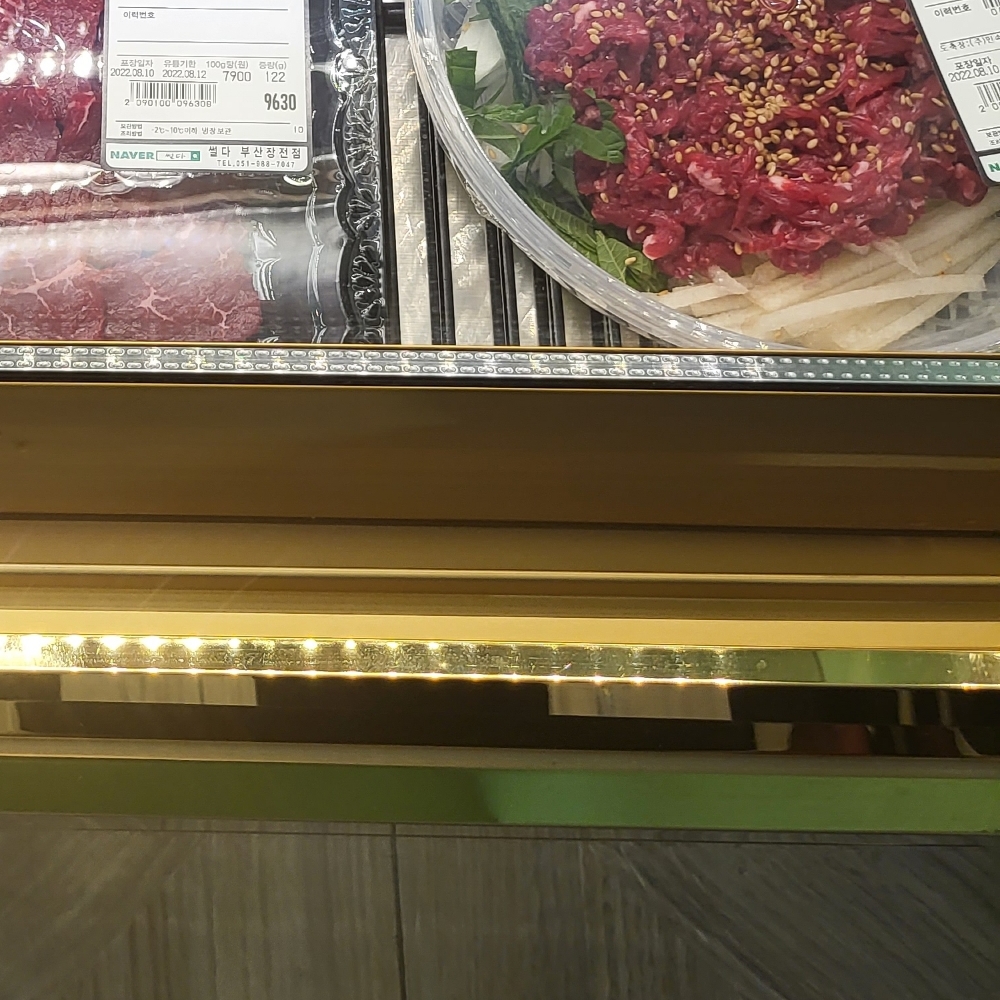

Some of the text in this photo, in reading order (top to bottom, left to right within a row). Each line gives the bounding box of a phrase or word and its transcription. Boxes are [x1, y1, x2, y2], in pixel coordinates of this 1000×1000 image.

[934, 4, 971, 17] 이력번호
[164, 60, 196, 68] 유통기한
[206, 61, 248, 69] 100g당(원)
[259, 62, 287, 70] 중량(g)
[954, 56, 991, 70] 포장일자
[111, 68, 285, 82] 2022.08.10 2022.08.12 7900 122
[948, 65, 999, 82] 2022.08.10
[264, 93, 296, 110] 9630
[111, 146, 300, 159] NAVER 썰다 부산장전점
